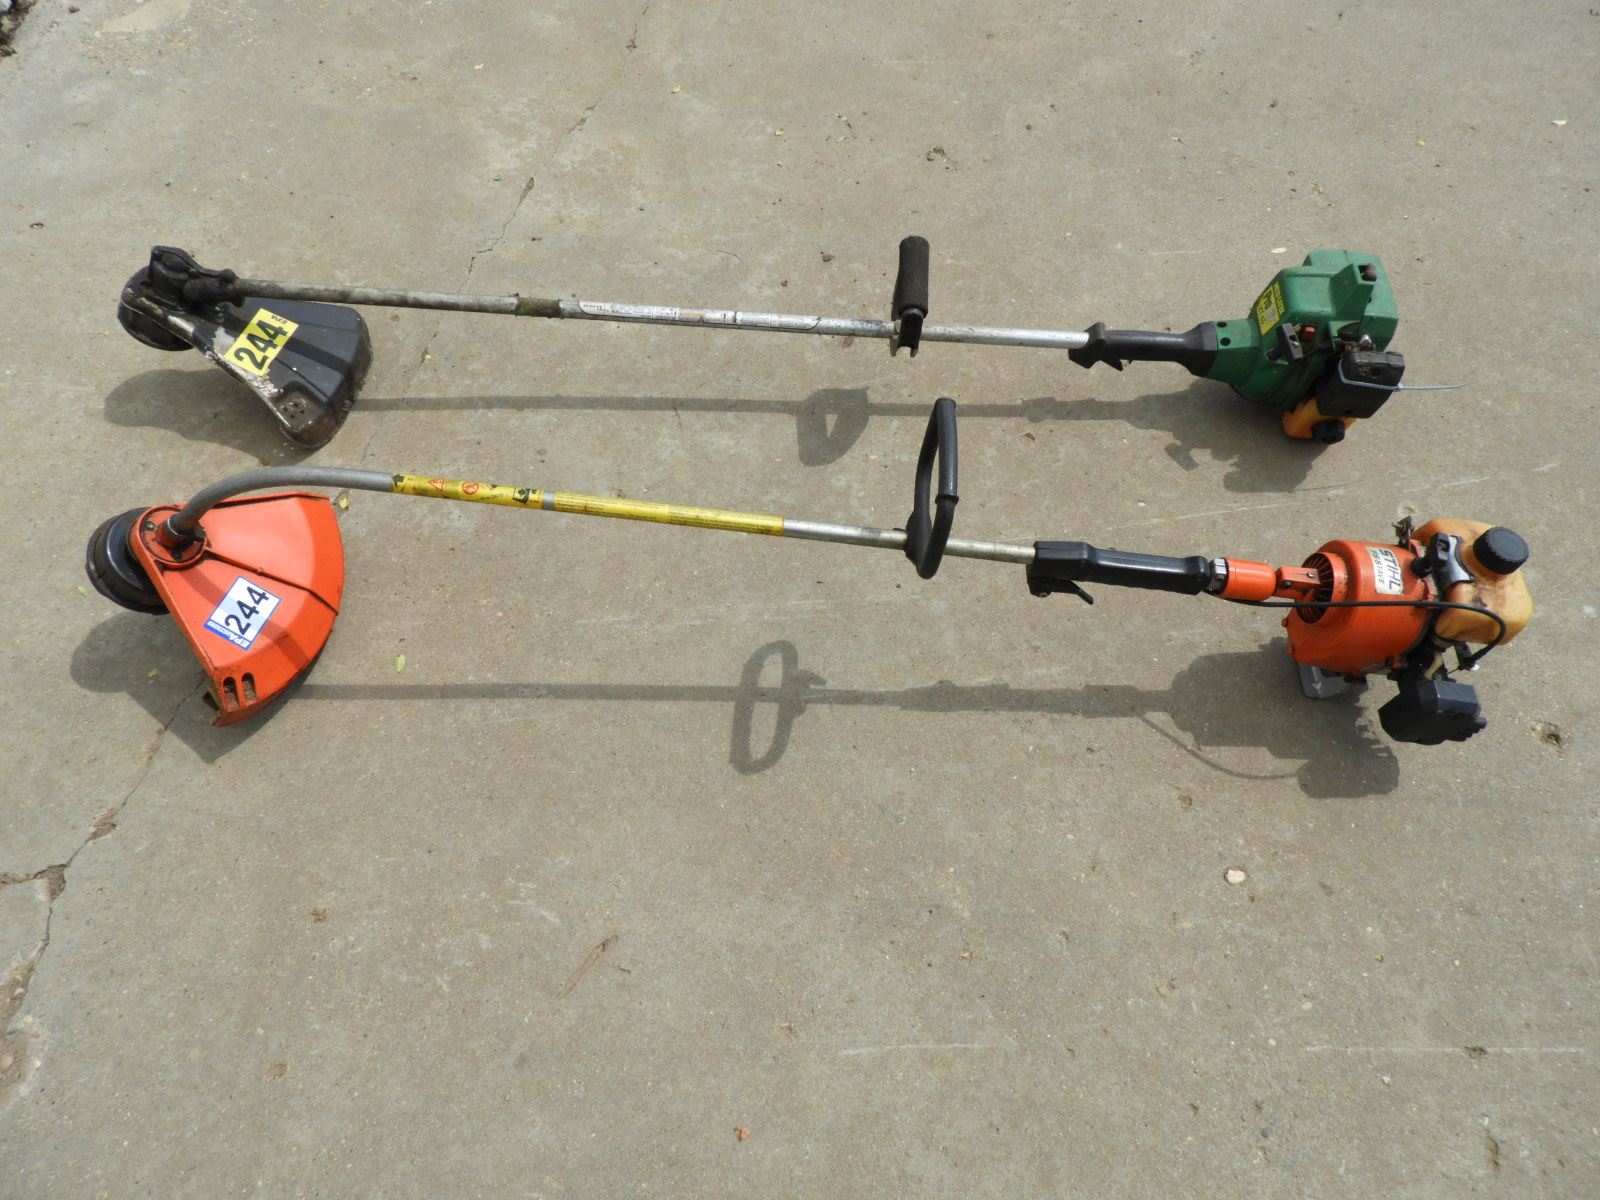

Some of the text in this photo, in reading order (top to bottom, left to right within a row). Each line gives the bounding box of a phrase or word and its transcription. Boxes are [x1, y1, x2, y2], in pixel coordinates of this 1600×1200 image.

[233, 319, 288, 371] 244
[1379, 549, 1401, 590] STIHL
[224, 586, 270, 636] 244
